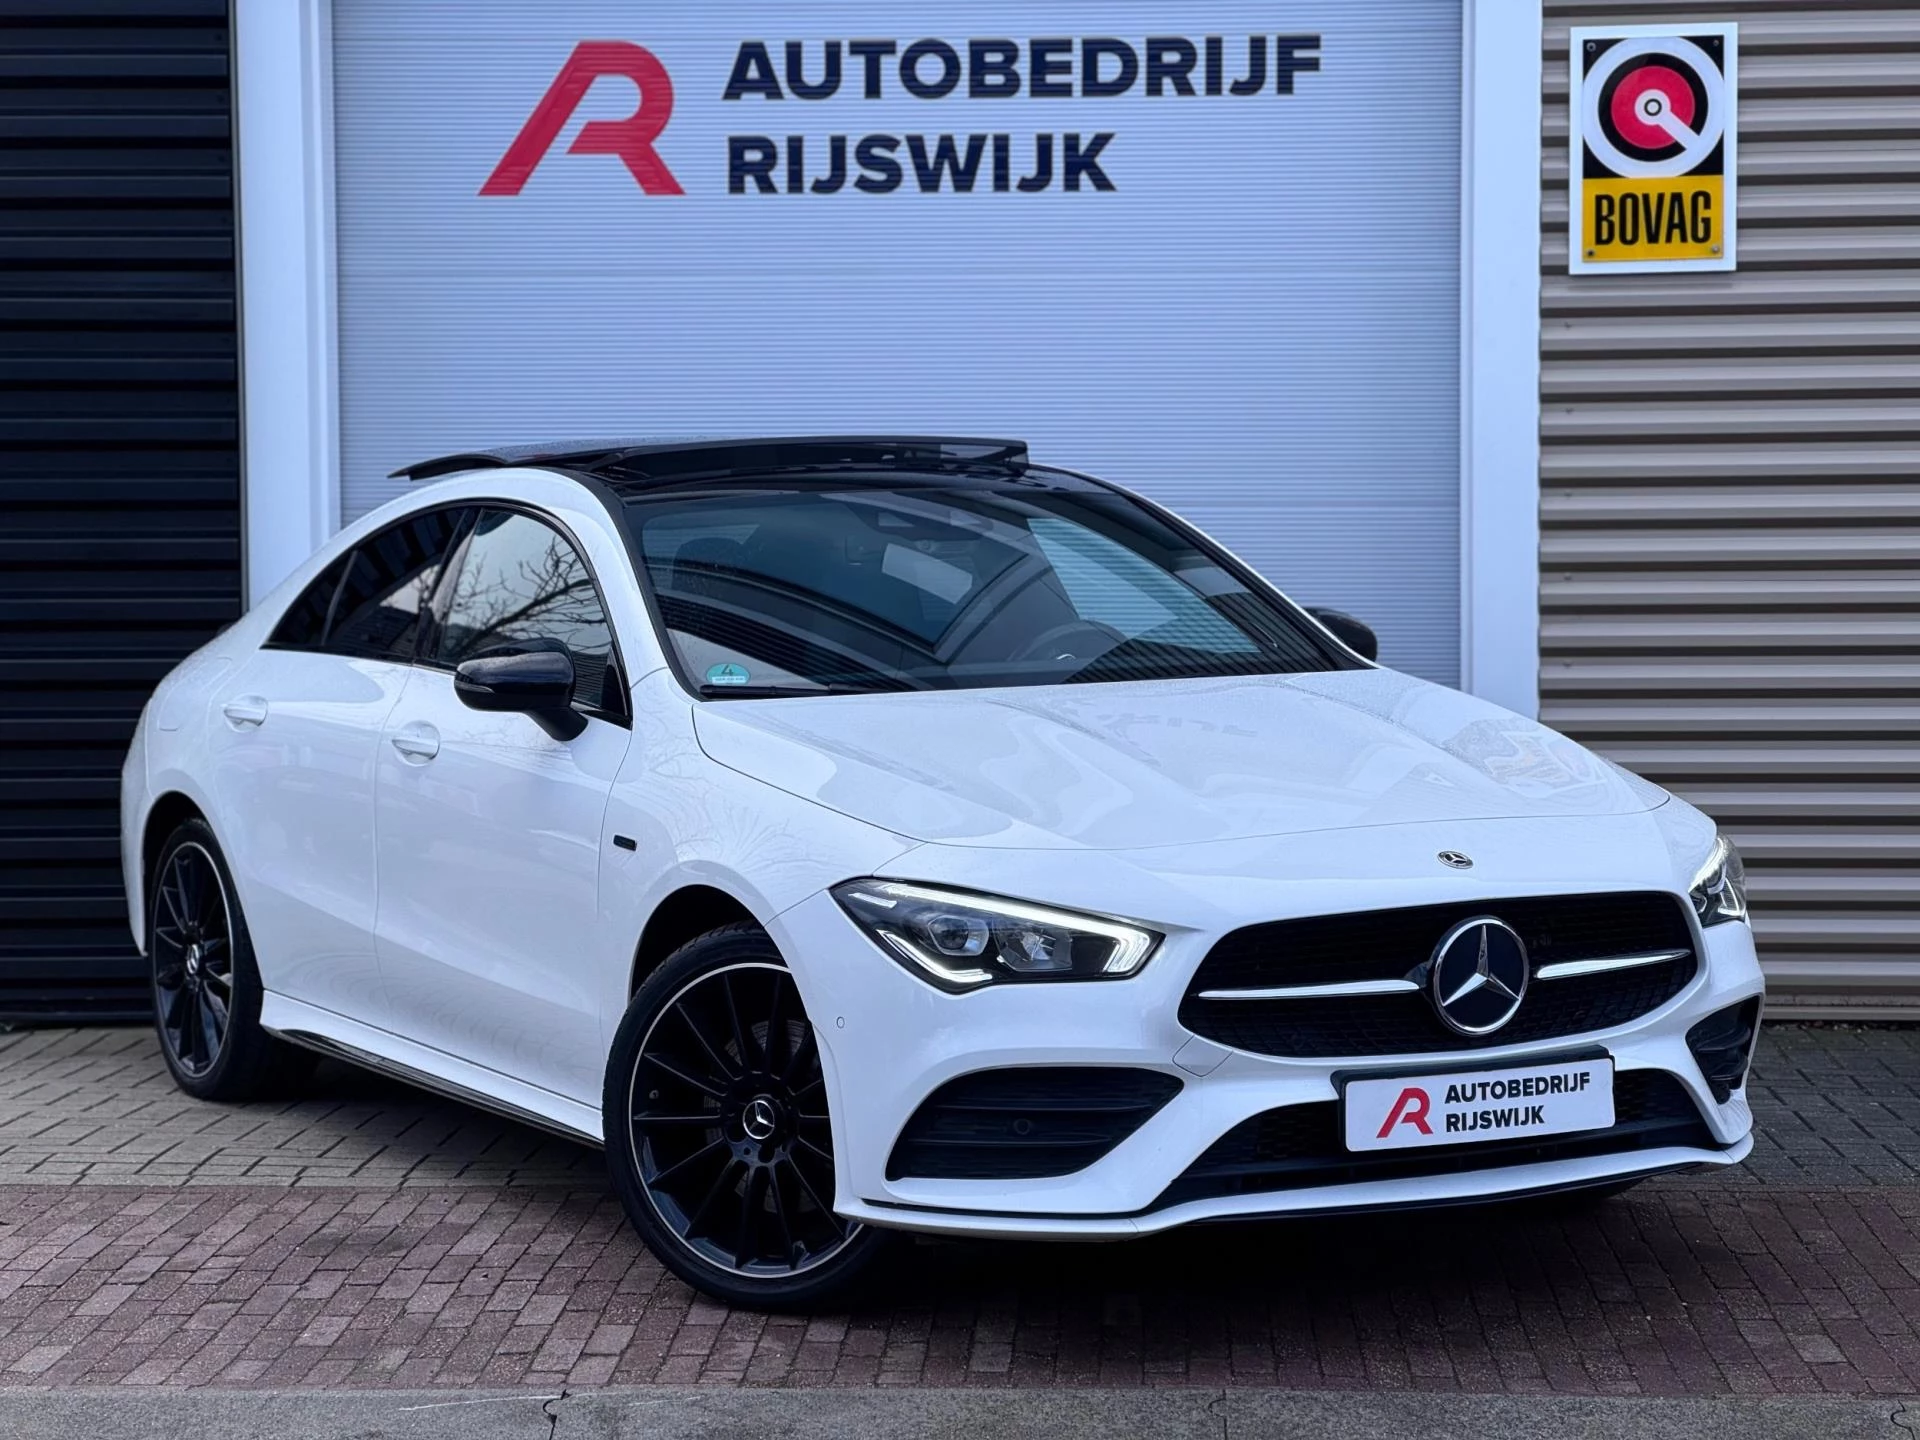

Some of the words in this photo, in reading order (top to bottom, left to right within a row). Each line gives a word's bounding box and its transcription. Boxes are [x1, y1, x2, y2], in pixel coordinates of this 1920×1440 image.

[722, 35, 1322, 99] AUTOBEDRIJF
[726, 133, 1118, 195] RIJSWIJK
[1595, 190, 1711, 245] BOVAG
[721, 664, 734, 676] 4
[1444, 1072, 1591, 1104] AUTOBEDRIJF
[1446, 1105, 1544, 1133] RIJSWIJK
